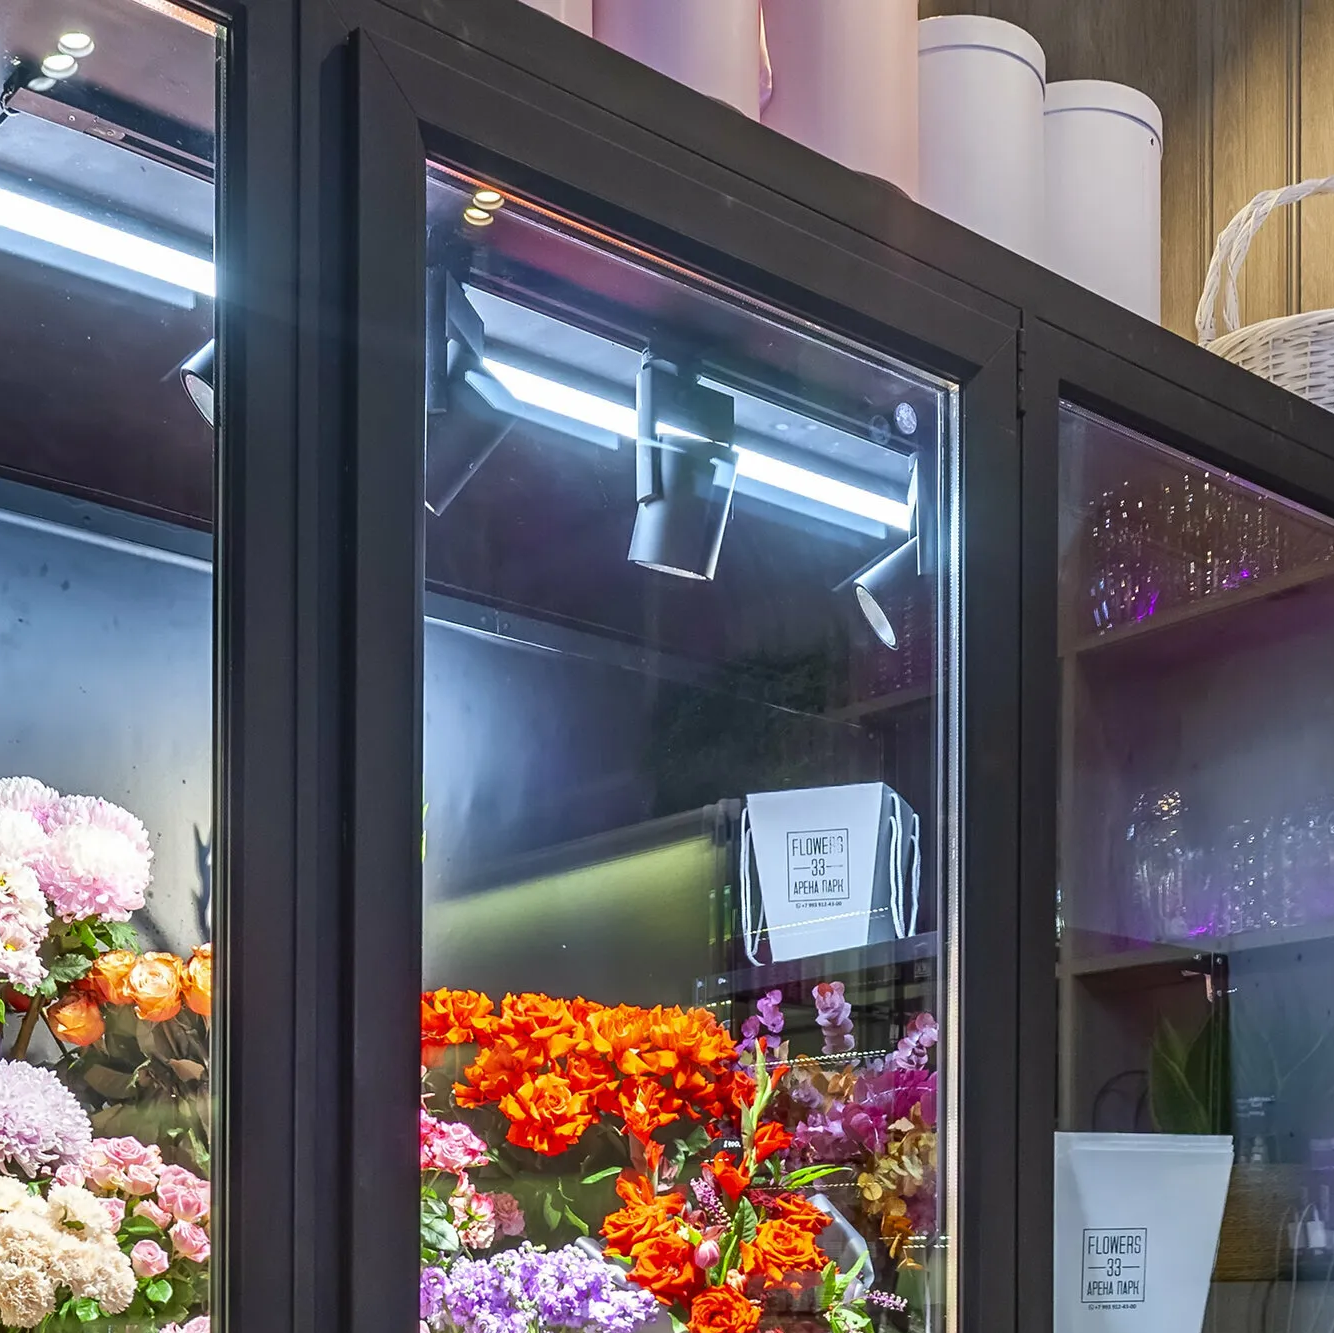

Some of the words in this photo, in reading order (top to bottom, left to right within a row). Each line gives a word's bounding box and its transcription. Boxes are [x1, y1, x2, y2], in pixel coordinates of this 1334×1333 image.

[792, 836, 844, 857] FLOWERS
[811, 858, 825, 876] 33
[793, 880, 819, 895] АРЕНА
[822, 879, 844, 894] ПАРК
[1088, 1235, 1142, 1255] FLOWERS
[1107, 1258, 1121, 1277] 33
[1087, 1280, 1113, 1296] АРЕНА
[1117, 1280, 1139, 1295] ПАРК
